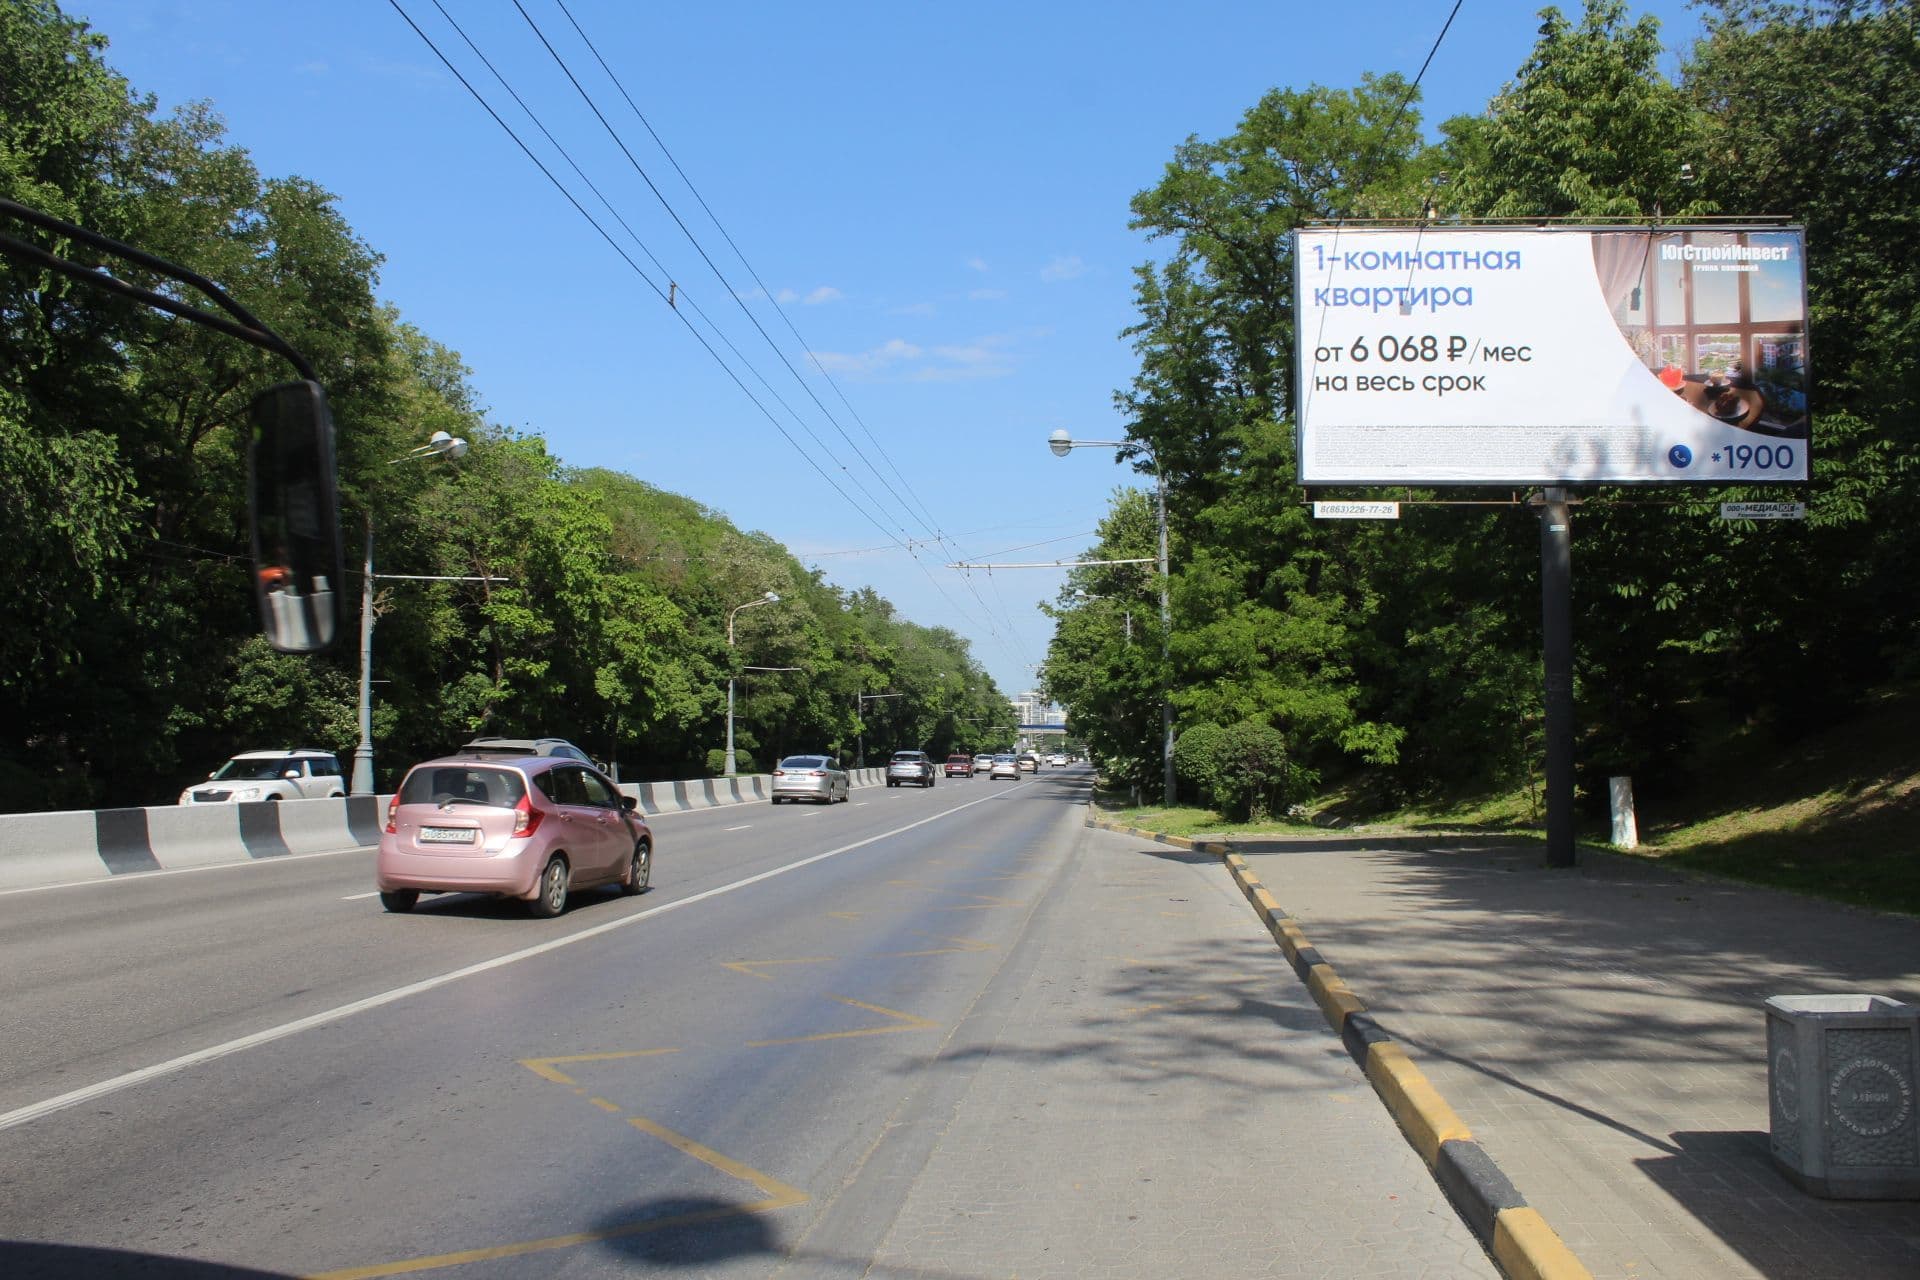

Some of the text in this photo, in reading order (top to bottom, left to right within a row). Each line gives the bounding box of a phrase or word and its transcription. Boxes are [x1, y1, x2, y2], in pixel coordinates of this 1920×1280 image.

[1312, 244, 1521, 271] 1-комнатная
[1662, 243, 1789, 262] ЮгСтройИнвест
[1314, 285, 1473, 313] квартира
[1314, 346, 1344, 362] от
[1350, 335, 1369, 362] 6
[1377, 335, 1439, 362] 068
[1315, 375, 1486, 397] на весь срок
[1320, 505, 1393, 514] 8(863)226-77-26
